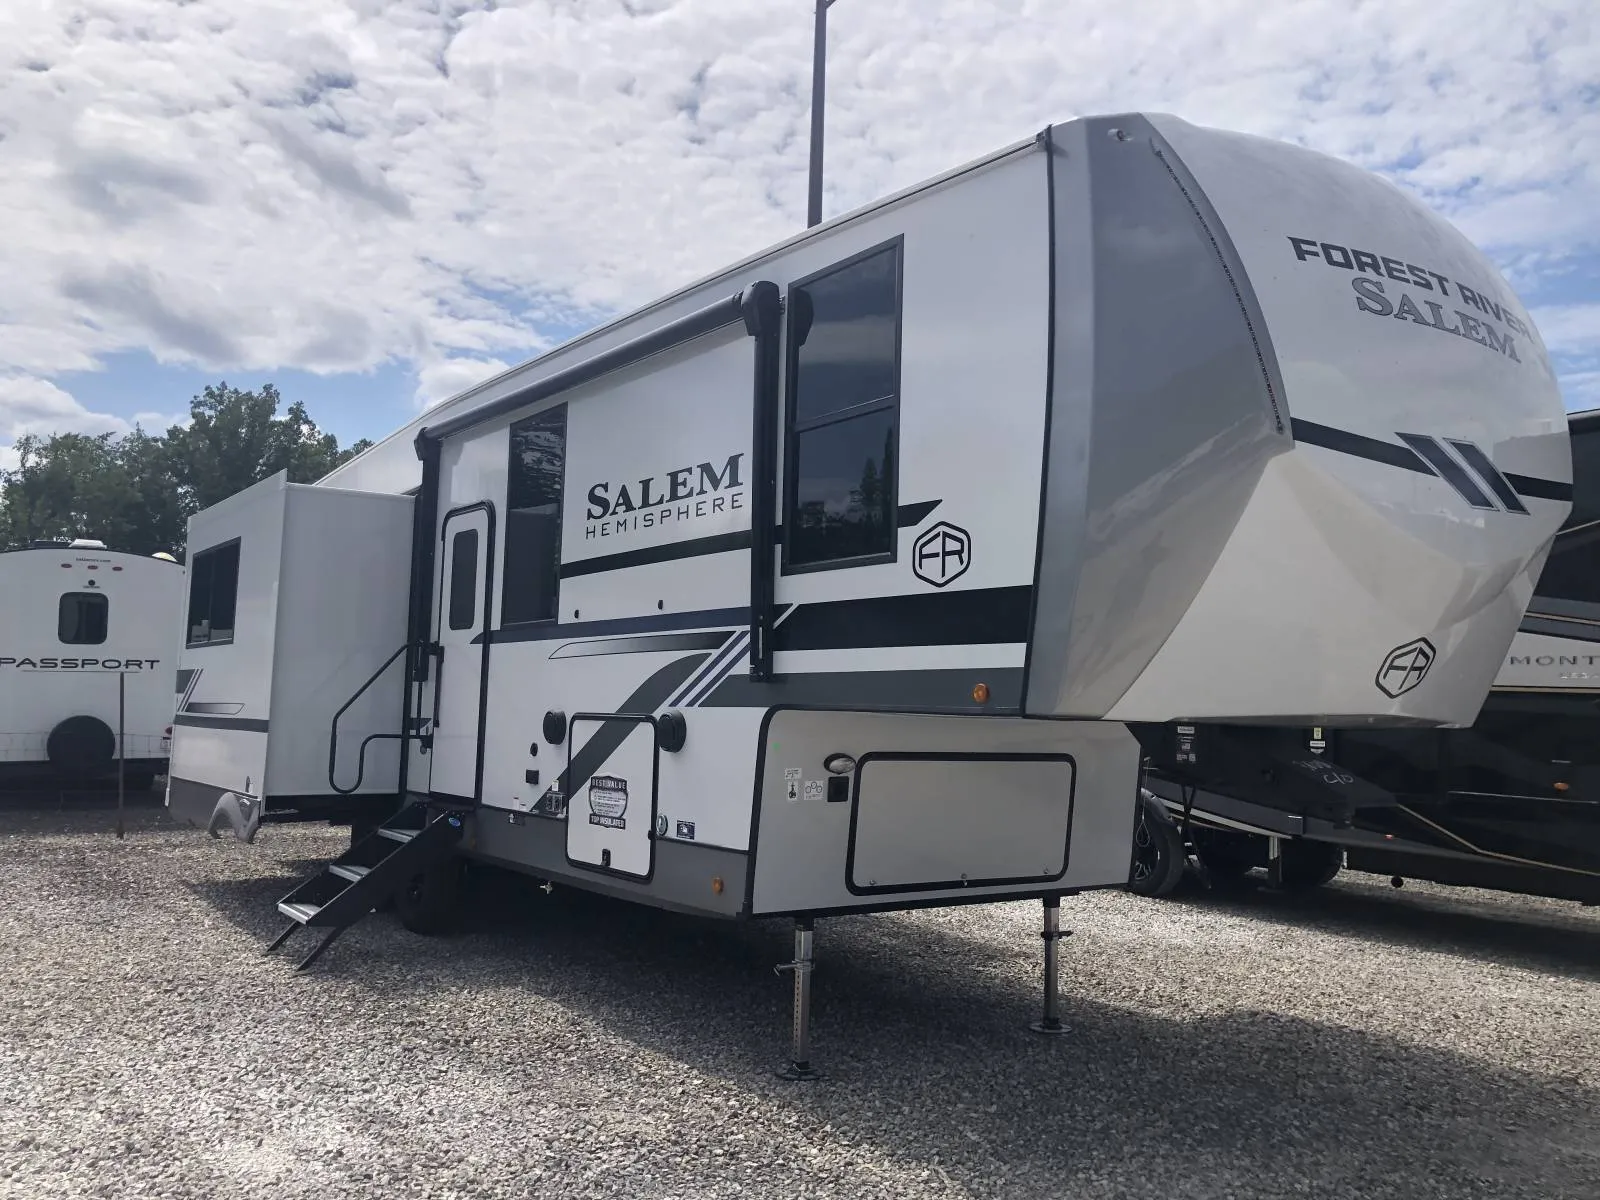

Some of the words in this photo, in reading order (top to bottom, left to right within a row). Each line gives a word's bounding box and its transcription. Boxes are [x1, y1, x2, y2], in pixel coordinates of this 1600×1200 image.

[1287, 236, 1450, 297] FOREST
[1455, 281, 1534, 344] RIVER
[1351, 277, 1522, 364] SALEM
[586, 452, 745, 521] SALEM
[585, 492, 744, 540] HEMISPHERE
[0, 657, 160, 670] PASSPORT
[1510, 655, 1600, 666] MONT
[592, 778, 605, 787] BEST
[607, 780, 626, 790] VALUE
